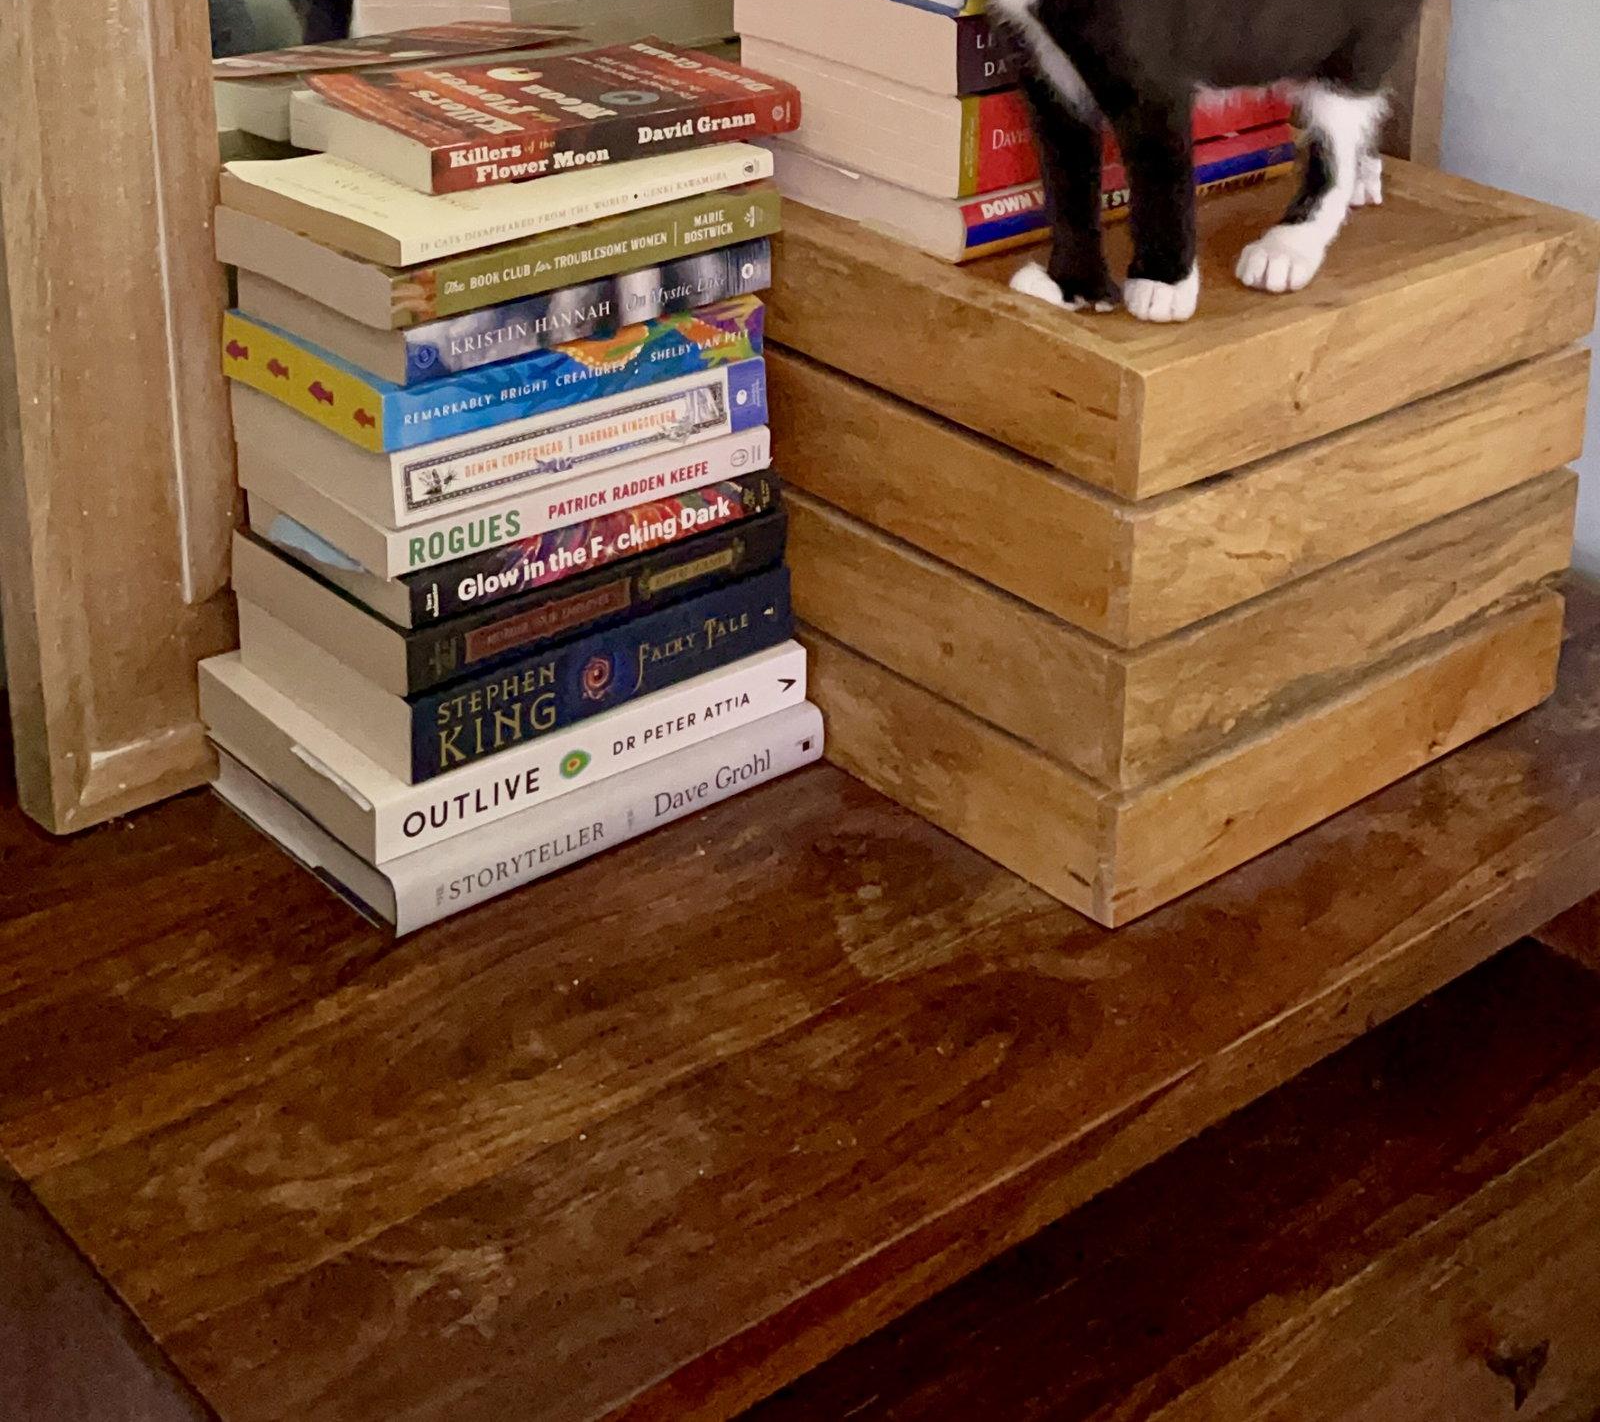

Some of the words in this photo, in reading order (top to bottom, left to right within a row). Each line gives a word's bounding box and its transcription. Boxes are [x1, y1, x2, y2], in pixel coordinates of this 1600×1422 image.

[410, 89, 525, 135] Killers
[424, 71, 540, 115] Flower
[520, 84, 618, 119] Moon
[638, 119, 693, 144] David
[697, 112, 756, 134] Grann
[450, 143, 521, 168] Killers
[477, 157, 548, 183] Flower
[554, 149, 609, 169] Moon
[434, 236, 461, 250] CATS
[465, 217, 534, 241] DISAPPEARED
[538, 209, 567, 224] FROM
[593, 195, 628, 209] WORLD
[694, 209, 725, 226] MARIE
[981, 193, 1032, 219] DOWN
[684, 222, 733, 244] BOSTWICK
[444, 281, 465, 295] The
[470, 272, 500, 289] BOOK
[503, 264, 530, 282] CLUB
[533, 260, 551, 277] for
[553, 240, 627, 269] TROUBLESOME
[630, 232, 668, 250] WOMEN
[651, 283, 692, 306] Mystic
[451, 323, 527, 356] KRISTIN
[535, 300, 611, 333] HANNAH
[650, 344, 691, 363] SHELBY
[697, 335, 720, 352] VAN
[725, 329, 749, 344] PELT
[404, 393, 492, 425] REMARKABLY
[501, 380, 548, 401] BRIGHT
[555, 363, 626, 387] CREATURES
[578, 426, 620, 446] BARBARA
[464, 461, 498, 478] DEMON
[502, 441, 563, 467] COPPERHEAD
[548, 489, 607, 519] PATRICK
[612, 474, 665, 502] RADDEN
[670, 461, 709, 485] KEEFE
[409, 510, 521, 567] ROGUES
[458, 568, 520, 601] Glow
[523, 555, 545, 581] in
[549, 546, 587, 572] the
[680, 496, 731, 529] Dark
[704, 612, 749, 650] TALE
[437, 662, 556, 725] STEPHEN
[439, 692, 556, 767] KING
[613, 735, 636, 756] DR
[644, 713, 697, 744] PETER
[704, 692, 751, 721] ATTIA
[403, 767, 540, 838] OUTLIVE
[654, 781, 709, 817] Dave
[715, 749, 771, 789] Grohl
[449, 821, 604, 900] STORYTELLER
